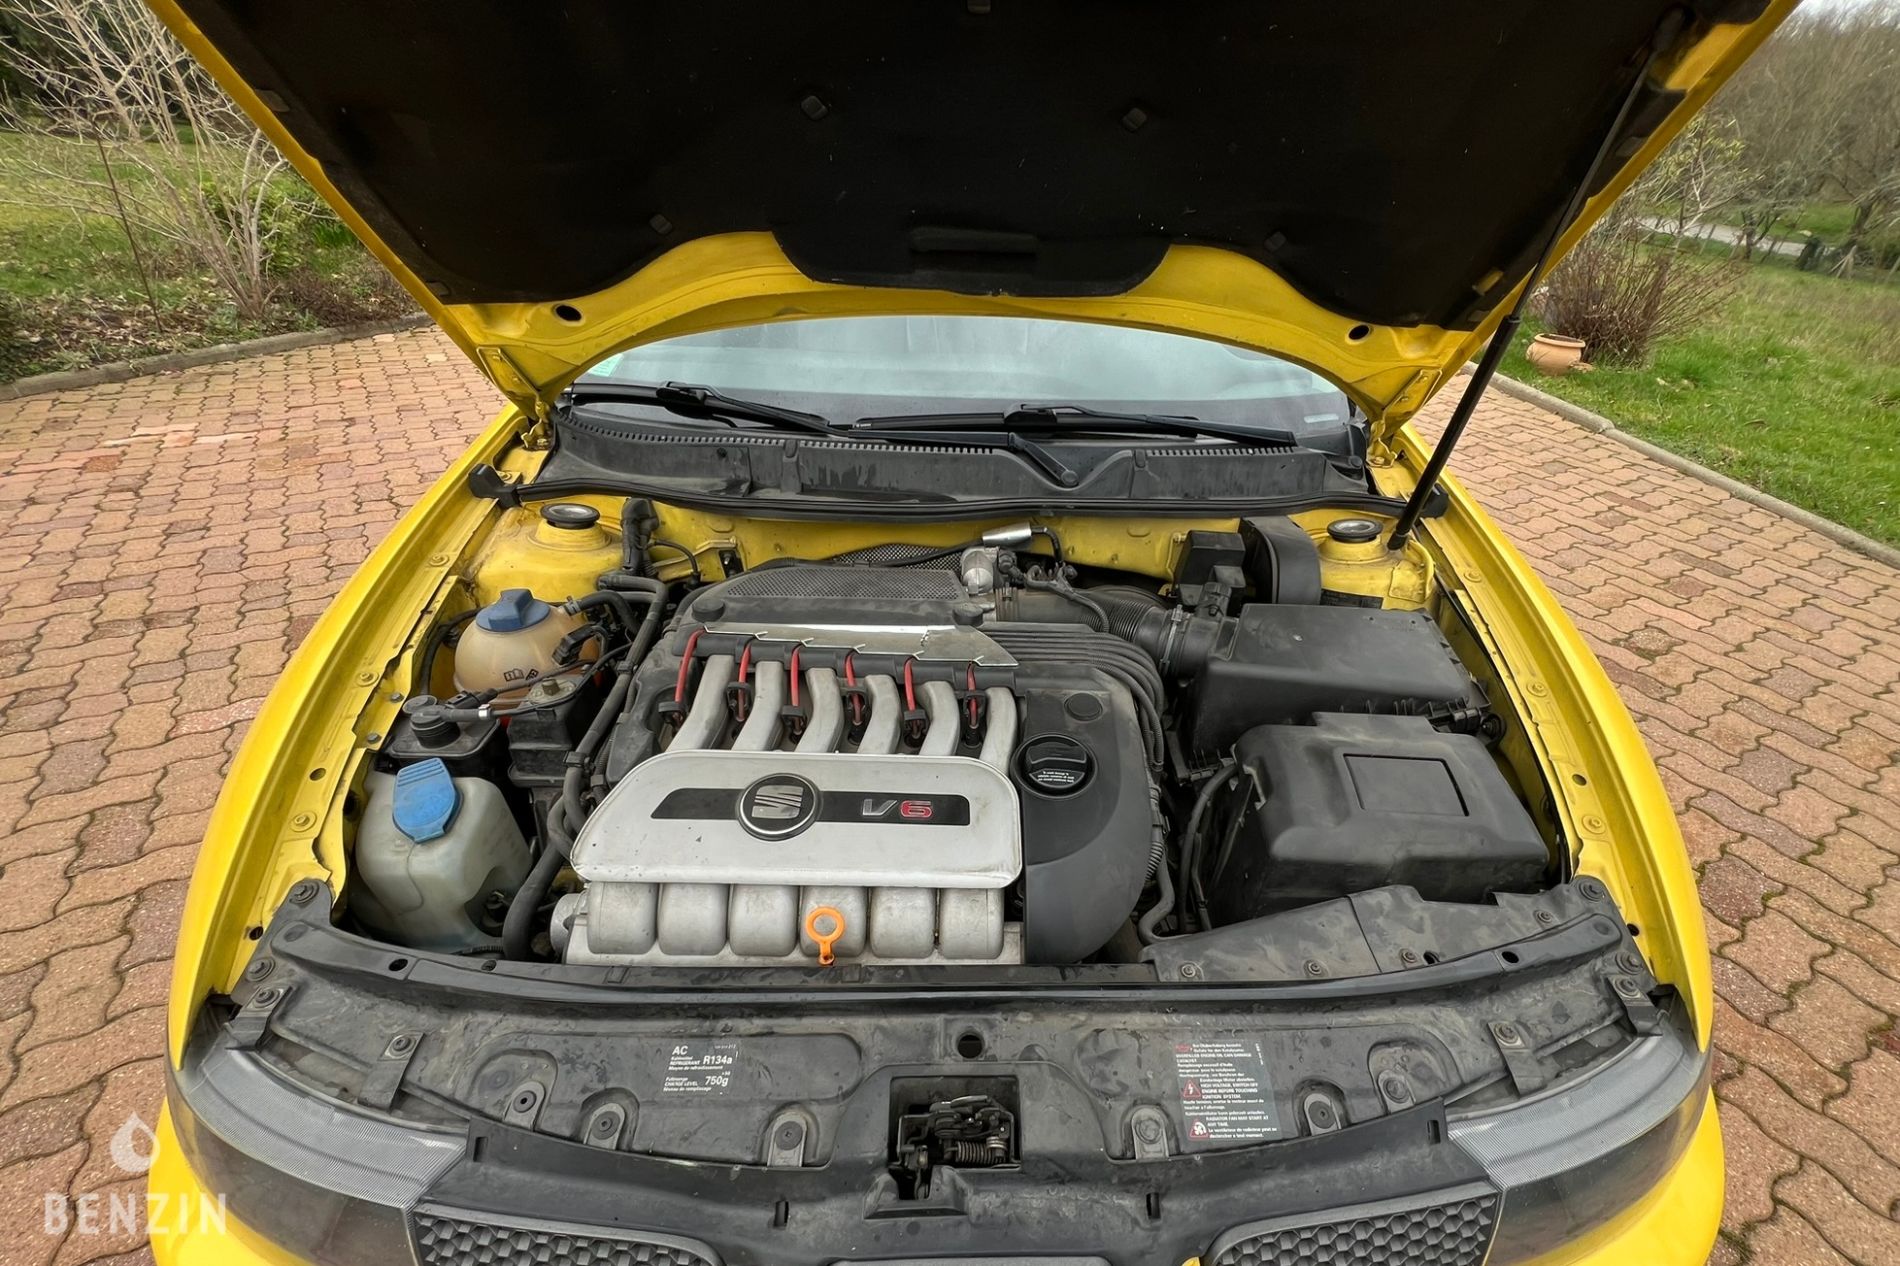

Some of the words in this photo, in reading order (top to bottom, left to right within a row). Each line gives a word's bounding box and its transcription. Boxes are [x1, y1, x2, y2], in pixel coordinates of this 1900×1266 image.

[862, 798, 932, 818] V6
[672, 1045, 688, 1055] AC
[703, 1055, 733, 1065] R134a
[705, 1075, 729, 1087] 750g
